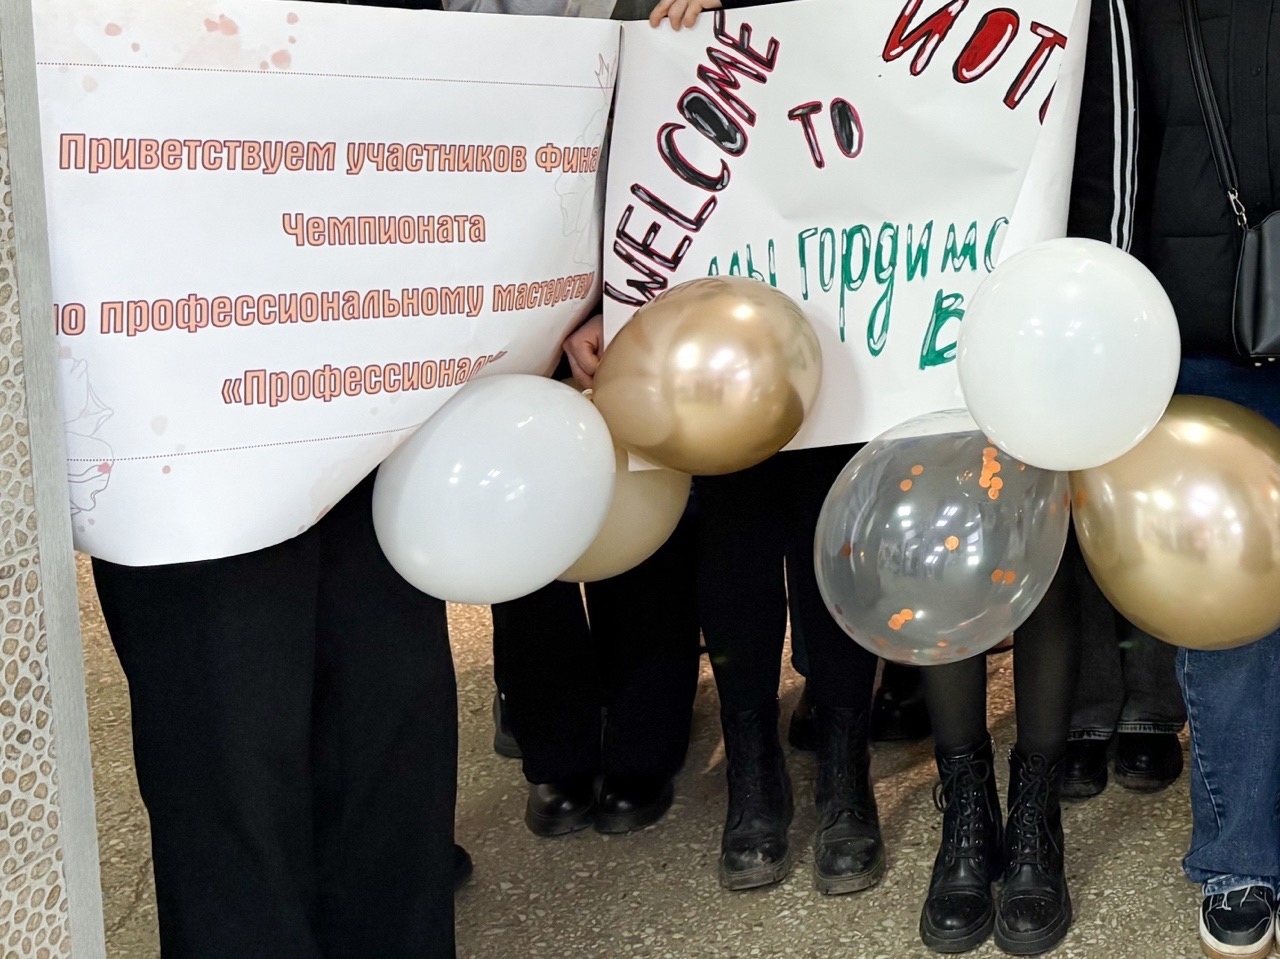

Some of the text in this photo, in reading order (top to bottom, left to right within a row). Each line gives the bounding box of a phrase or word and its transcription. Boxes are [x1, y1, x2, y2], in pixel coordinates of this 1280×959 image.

[59, 133, 600, 176] Приветствуем участников Фина
[604, 10, 780, 307] WELCOME
[282, 213, 486, 246] Чемпионата
[100, 285, 484, 337] профессиональному
[492, 271, 595, 312] мастерству
